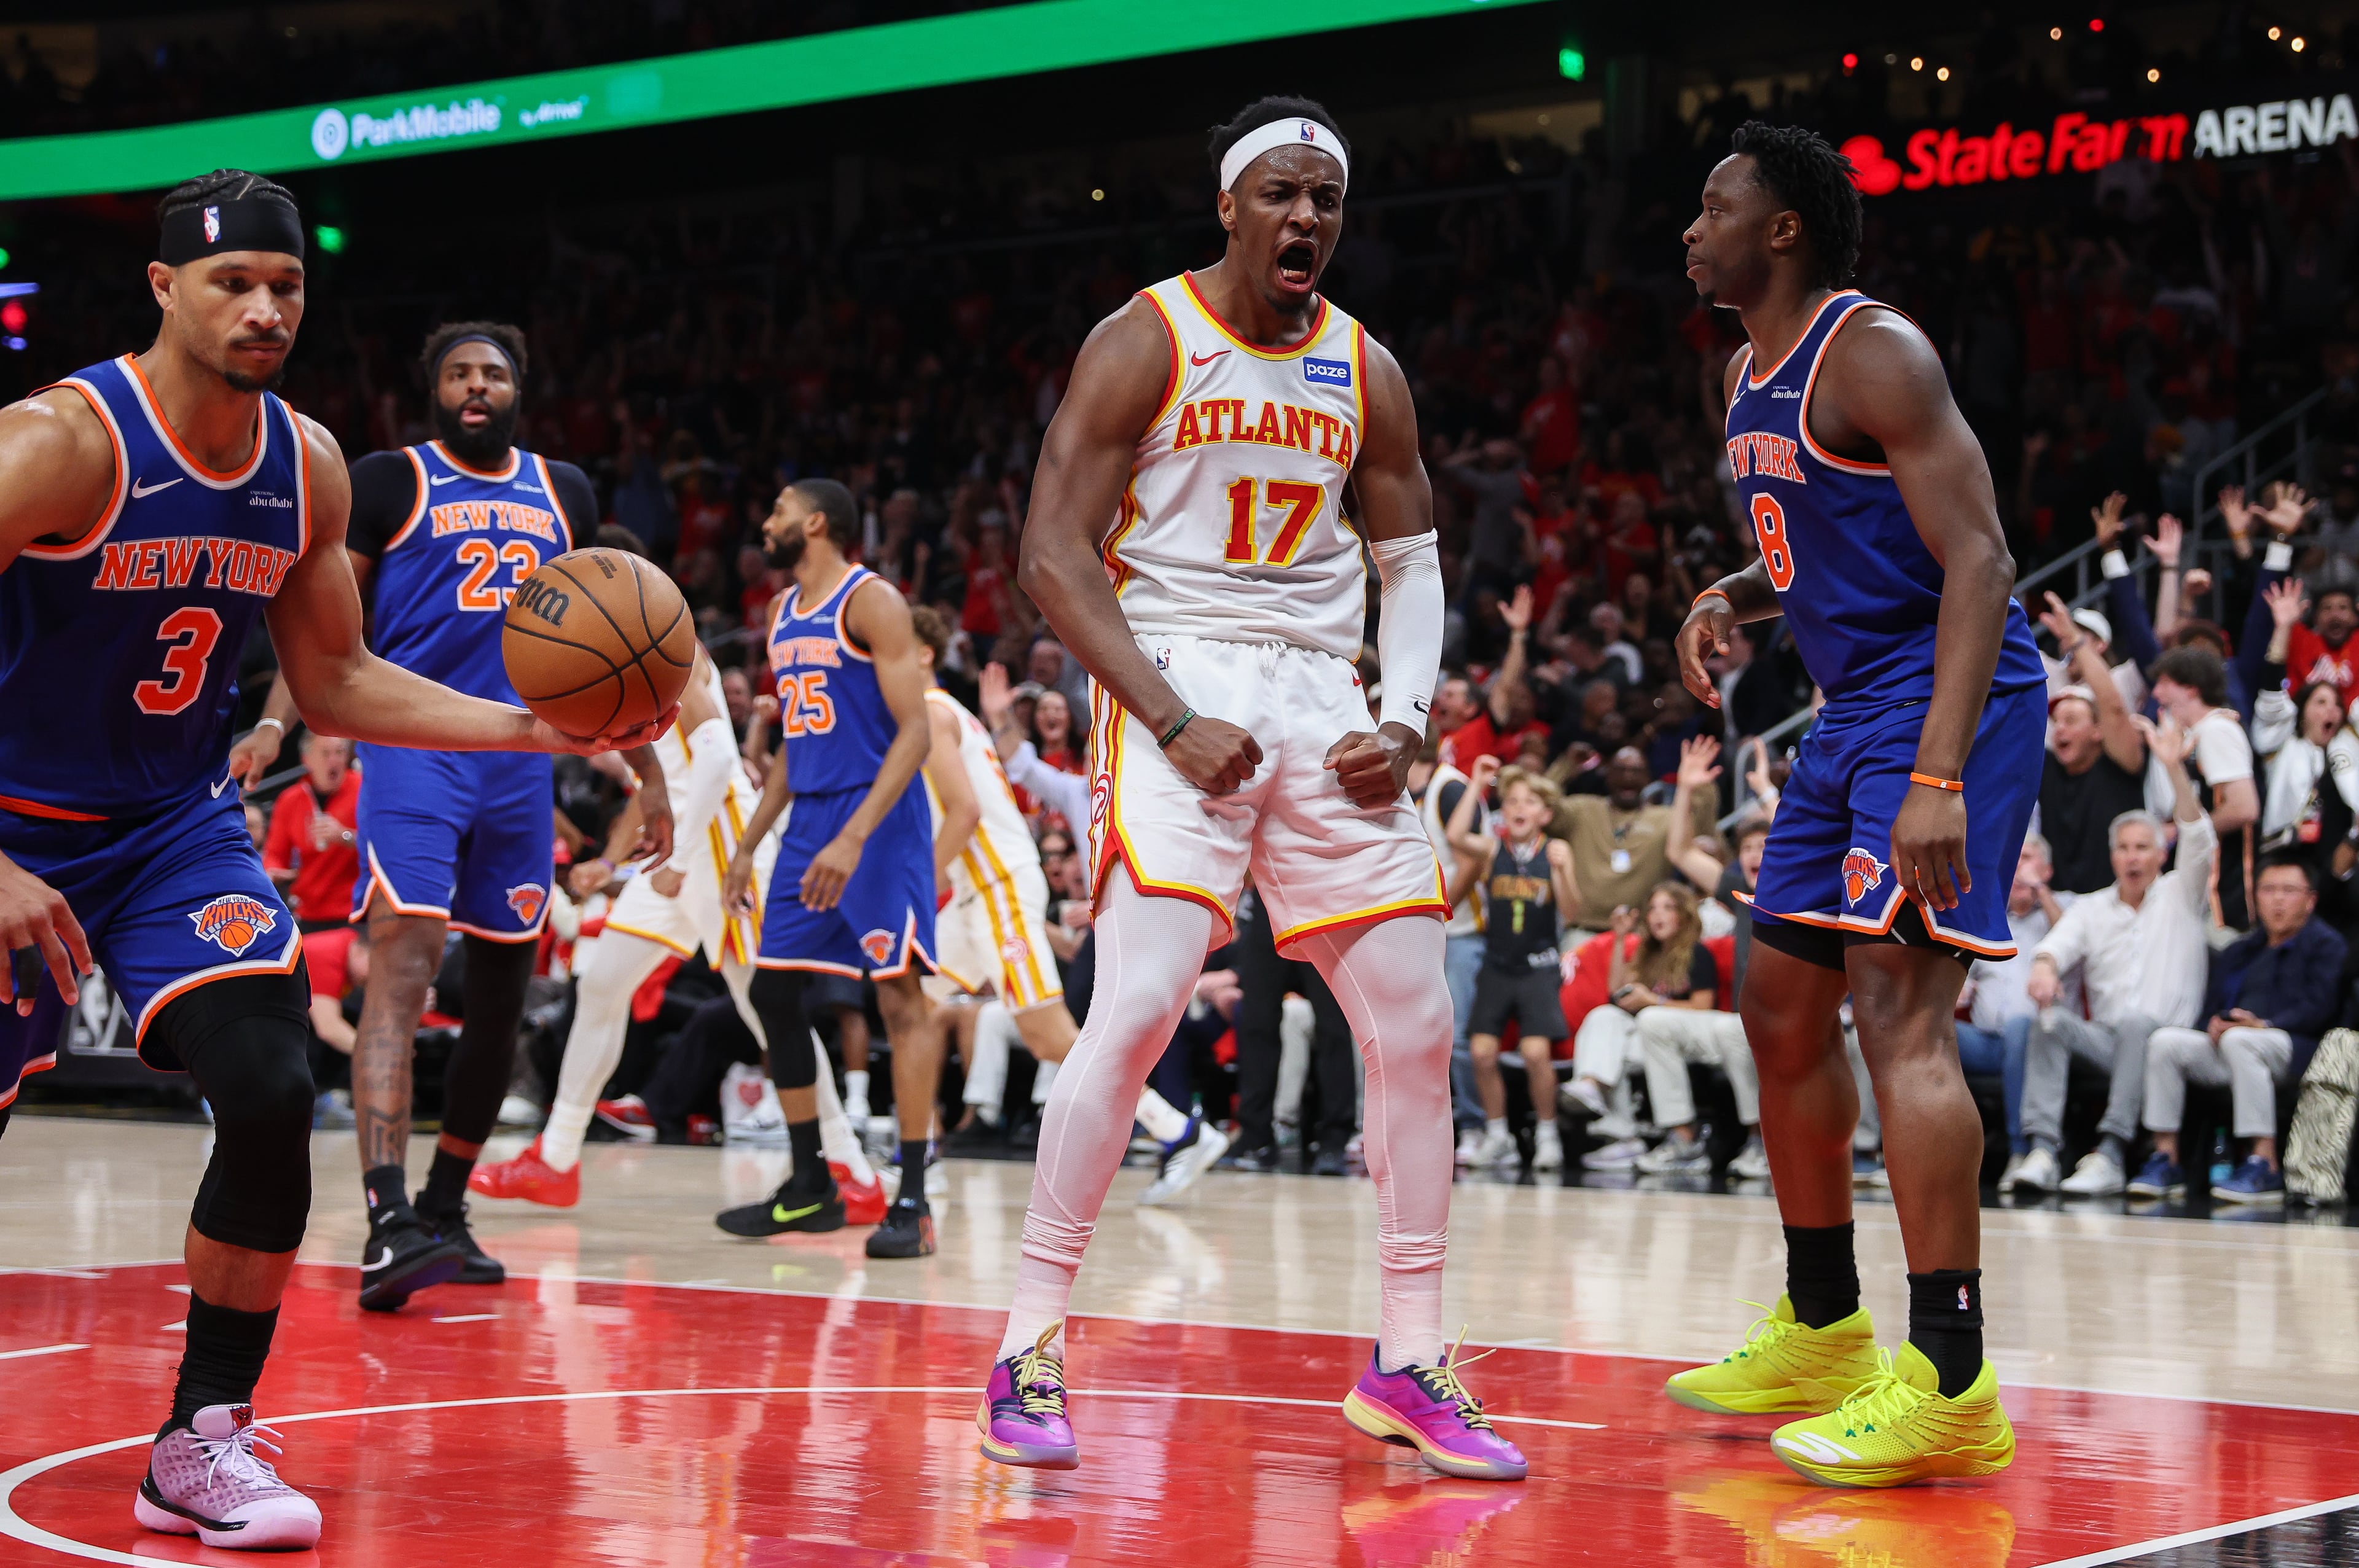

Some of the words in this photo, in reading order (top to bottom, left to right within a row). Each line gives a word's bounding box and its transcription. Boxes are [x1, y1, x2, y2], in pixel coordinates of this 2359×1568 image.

[351, 98, 501, 149] ParkMobile
[1902, 122, 2046, 190] State
[2046, 112, 2189, 174] Farm
[2194, 93, 2358, 160] ARENA
[1305, 363, 1347, 380] paze
[1173, 399, 1353, 473] ATLANTA
[1751, 431, 1807, 485] YORK
[249, 496, 267, 507] abu
[269, 497, 293, 508] dhabi
[430, 500, 490, 539] NEW
[490, 500, 557, 544] YORK
[1224, 476, 1324, 567] 17
[92, 536, 204, 591] NEW
[203, 536, 298, 598] YORK
[1750, 492, 1795, 591] 8
[456, 537, 542, 612] 23
[133, 606, 223, 716] 3
[777, 669, 836, 738] 25
[199, 902, 272, 933] KNICKS
